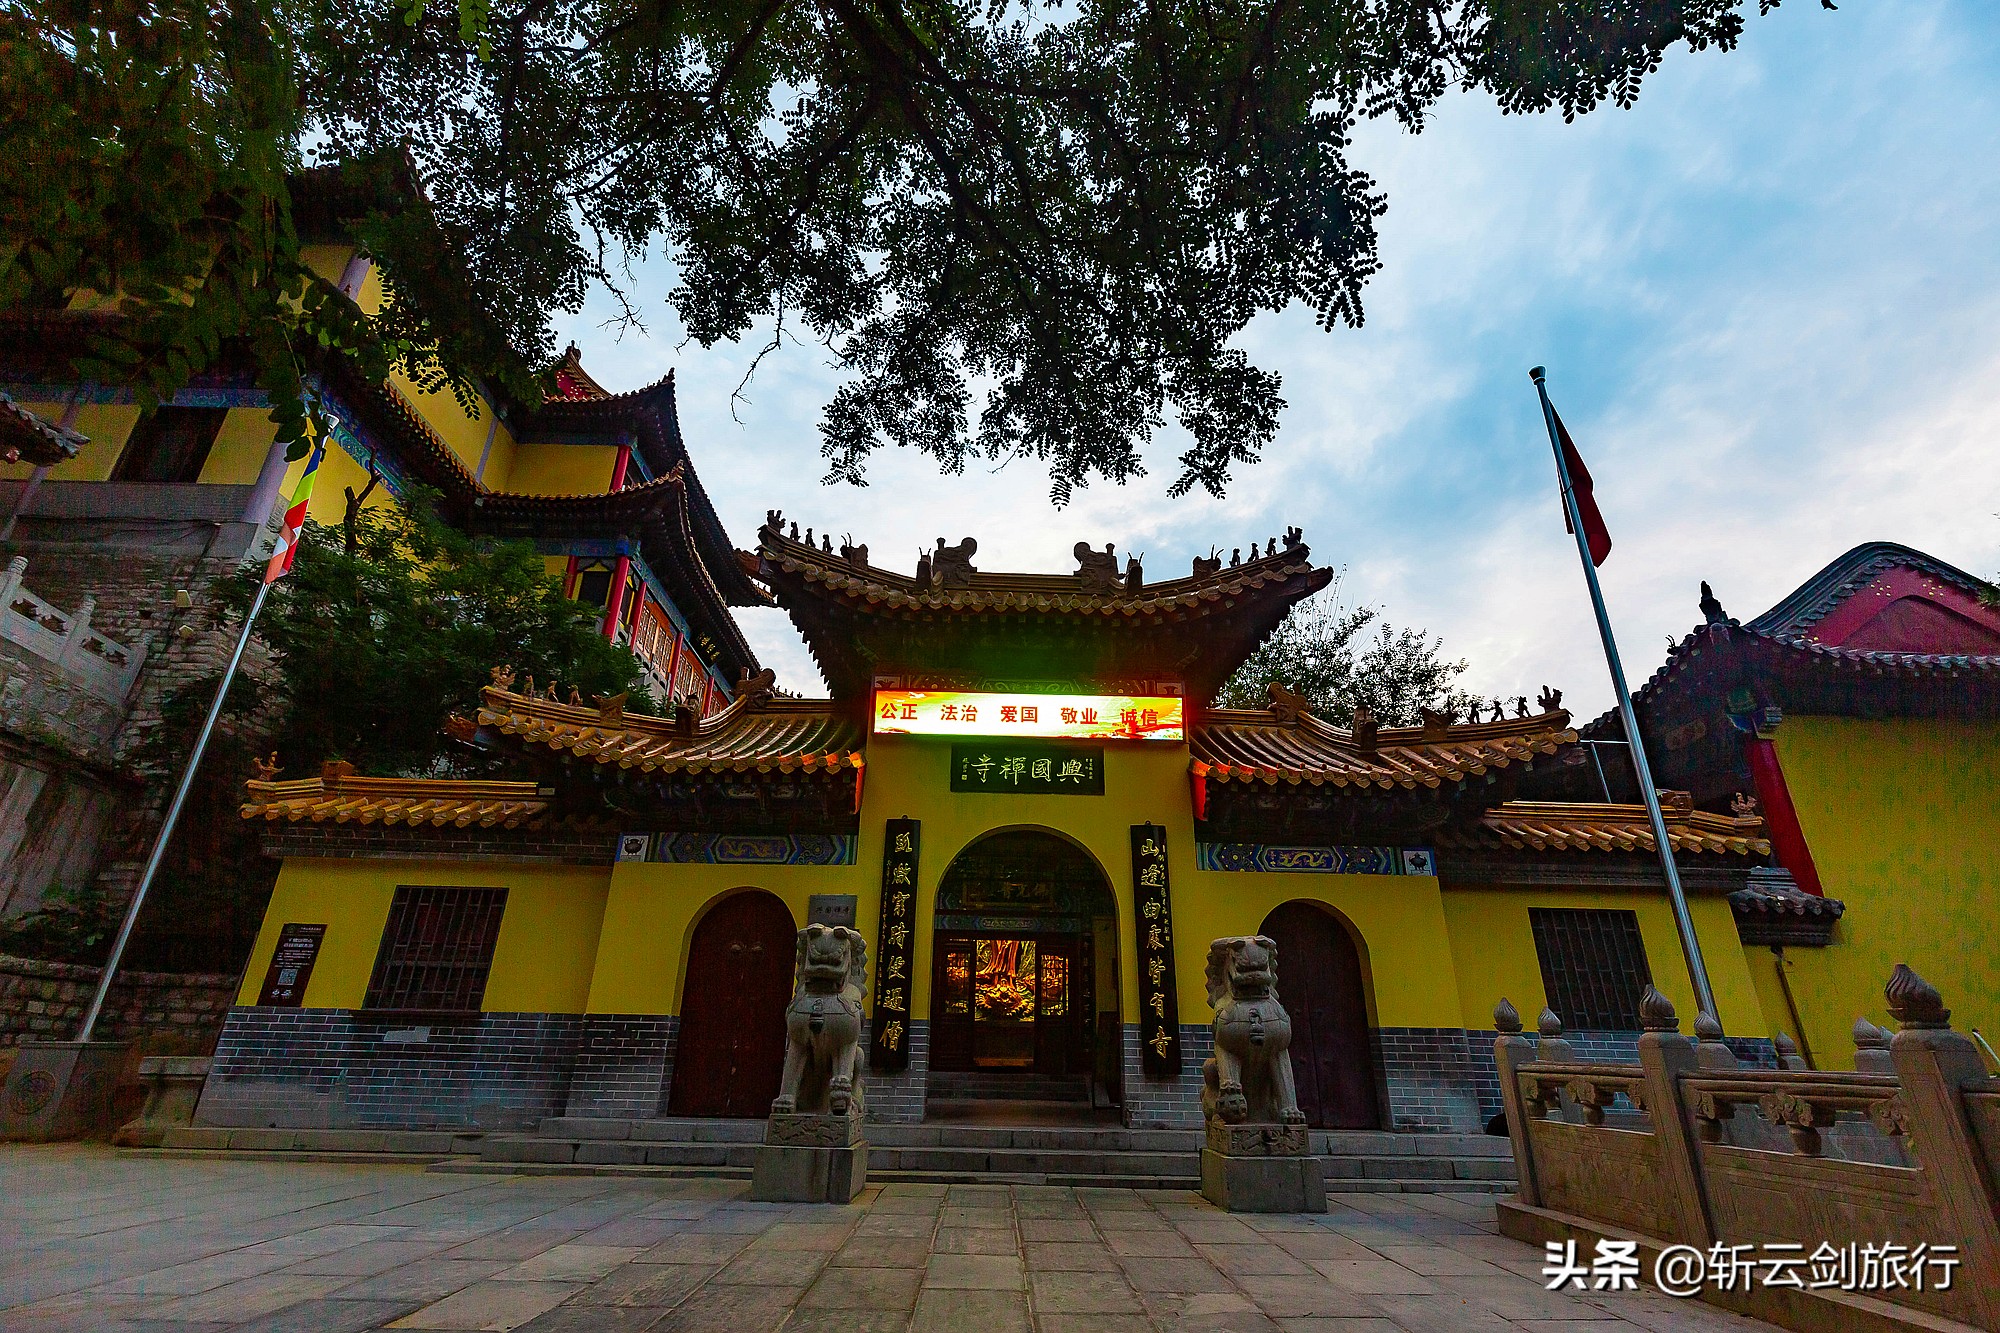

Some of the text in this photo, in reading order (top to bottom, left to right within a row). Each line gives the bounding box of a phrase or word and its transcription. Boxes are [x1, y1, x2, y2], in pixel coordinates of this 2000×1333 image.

[880, 702, 1159, 726] 公正 法治 爱国 敬业 诚信
